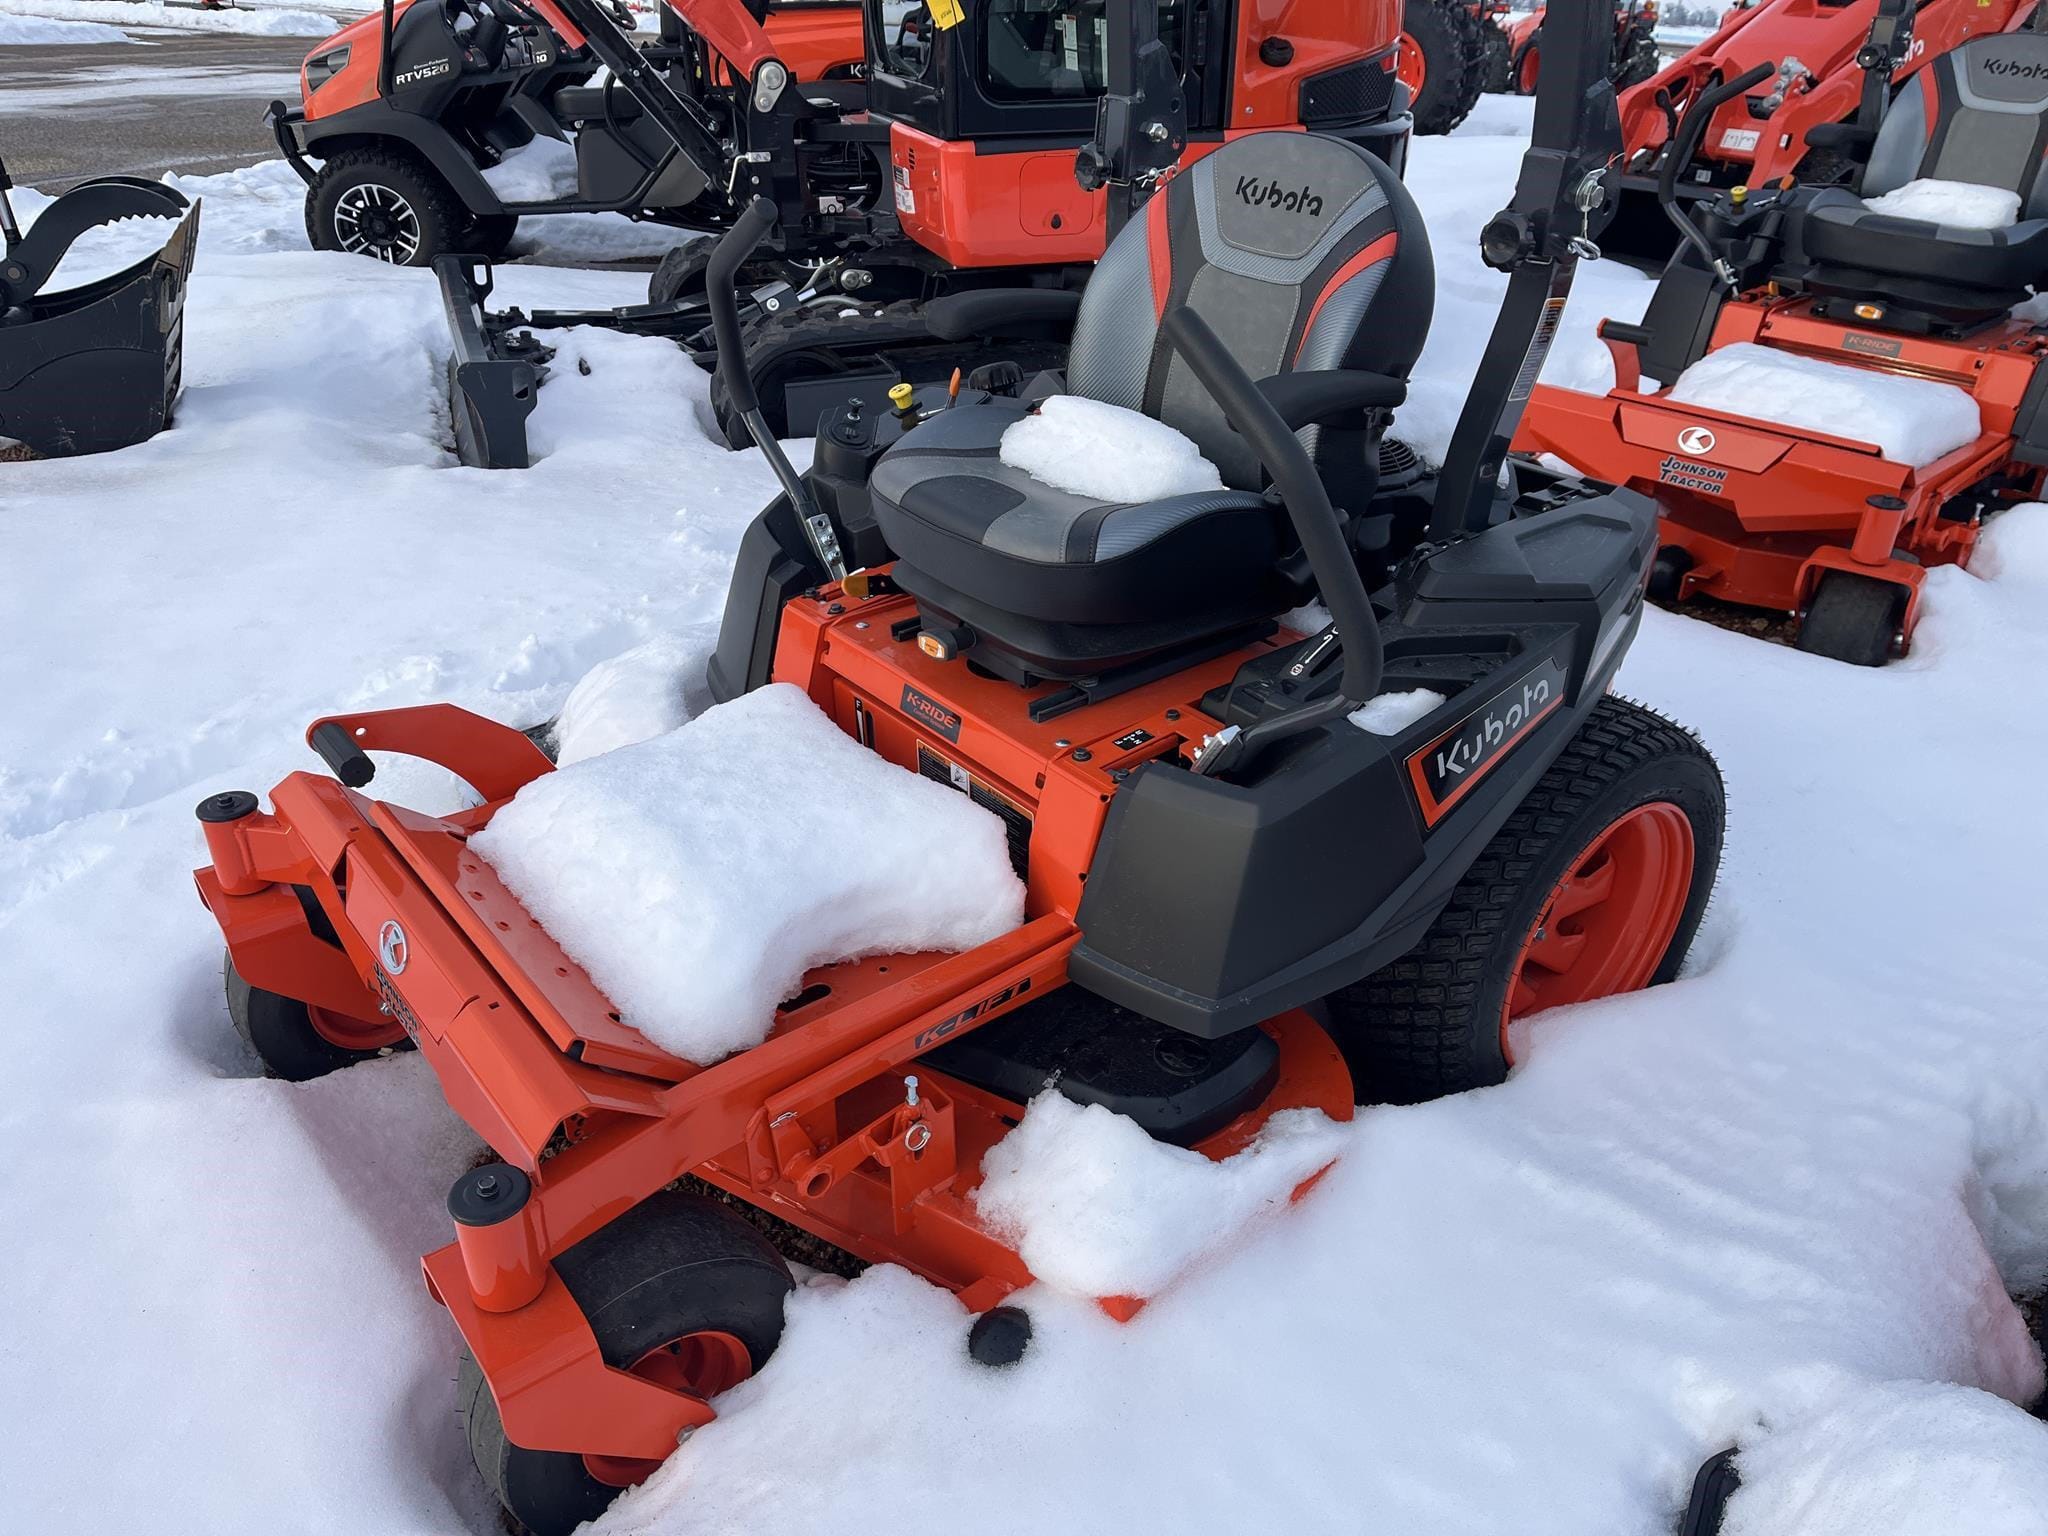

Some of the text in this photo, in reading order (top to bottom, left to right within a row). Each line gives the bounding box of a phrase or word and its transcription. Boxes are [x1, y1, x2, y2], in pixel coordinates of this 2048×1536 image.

[396, 63, 450, 85] RTV520
[1235, 175, 1323, 217] Kubota
[906, 692, 957, 729] K-RIDE
[1437, 679, 1549, 778] Kubota
[919, 978, 1030, 1048] K-LIFT
